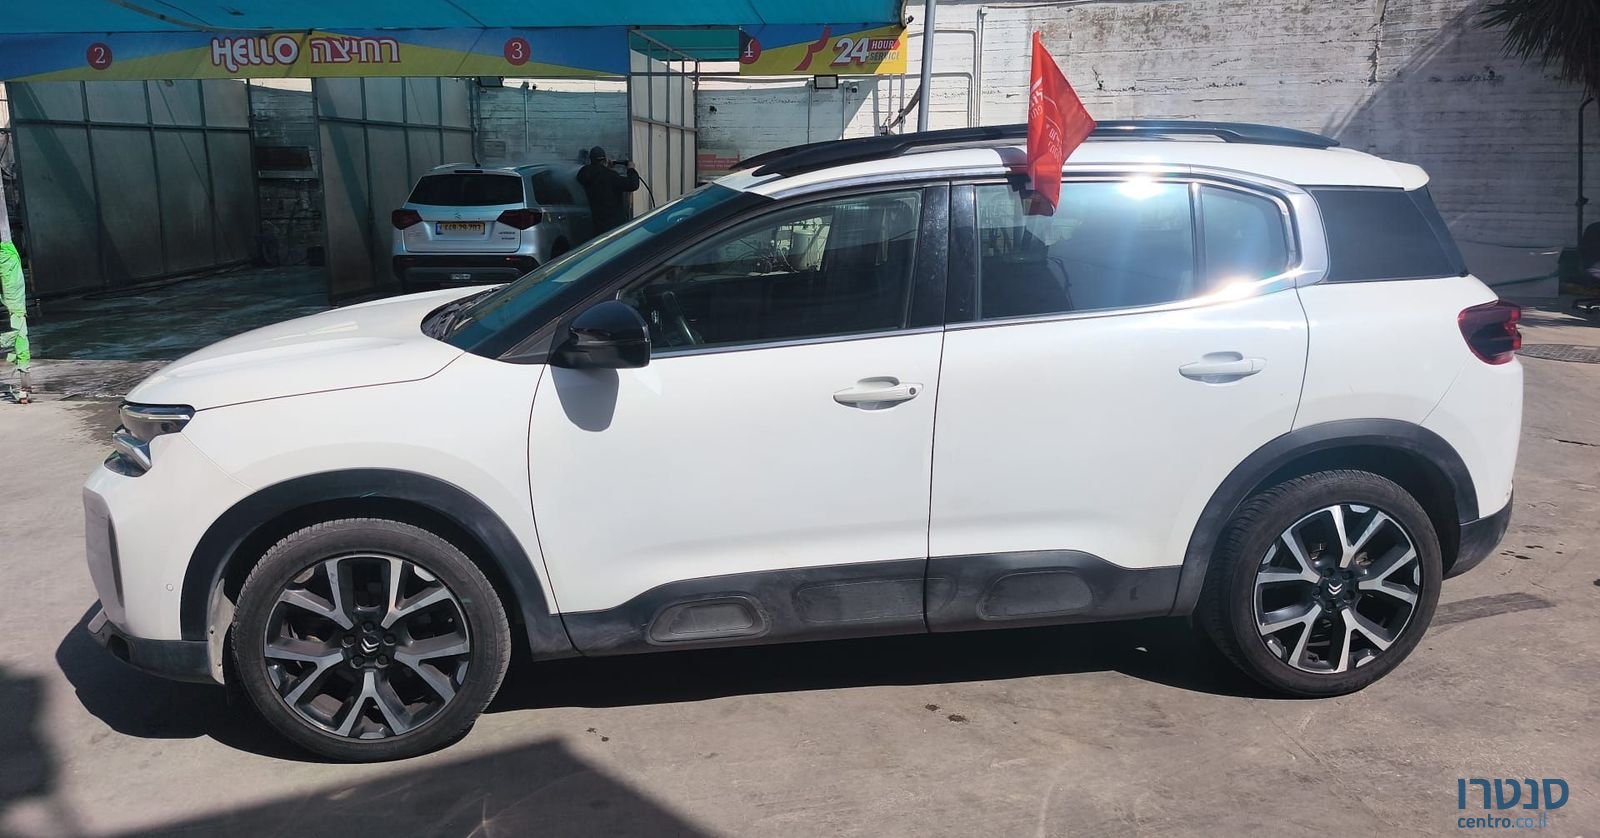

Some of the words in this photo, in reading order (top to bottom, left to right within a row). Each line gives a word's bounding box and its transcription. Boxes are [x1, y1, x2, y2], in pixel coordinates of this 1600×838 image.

[211, 37, 299, 73] HELLO
[310, 38, 400, 64] רחיצה
[511, 42, 524, 60] 3
[834, 37, 870, 64] 24
[870, 39, 895, 50] HOUR
[94, 47, 106, 65] 2
